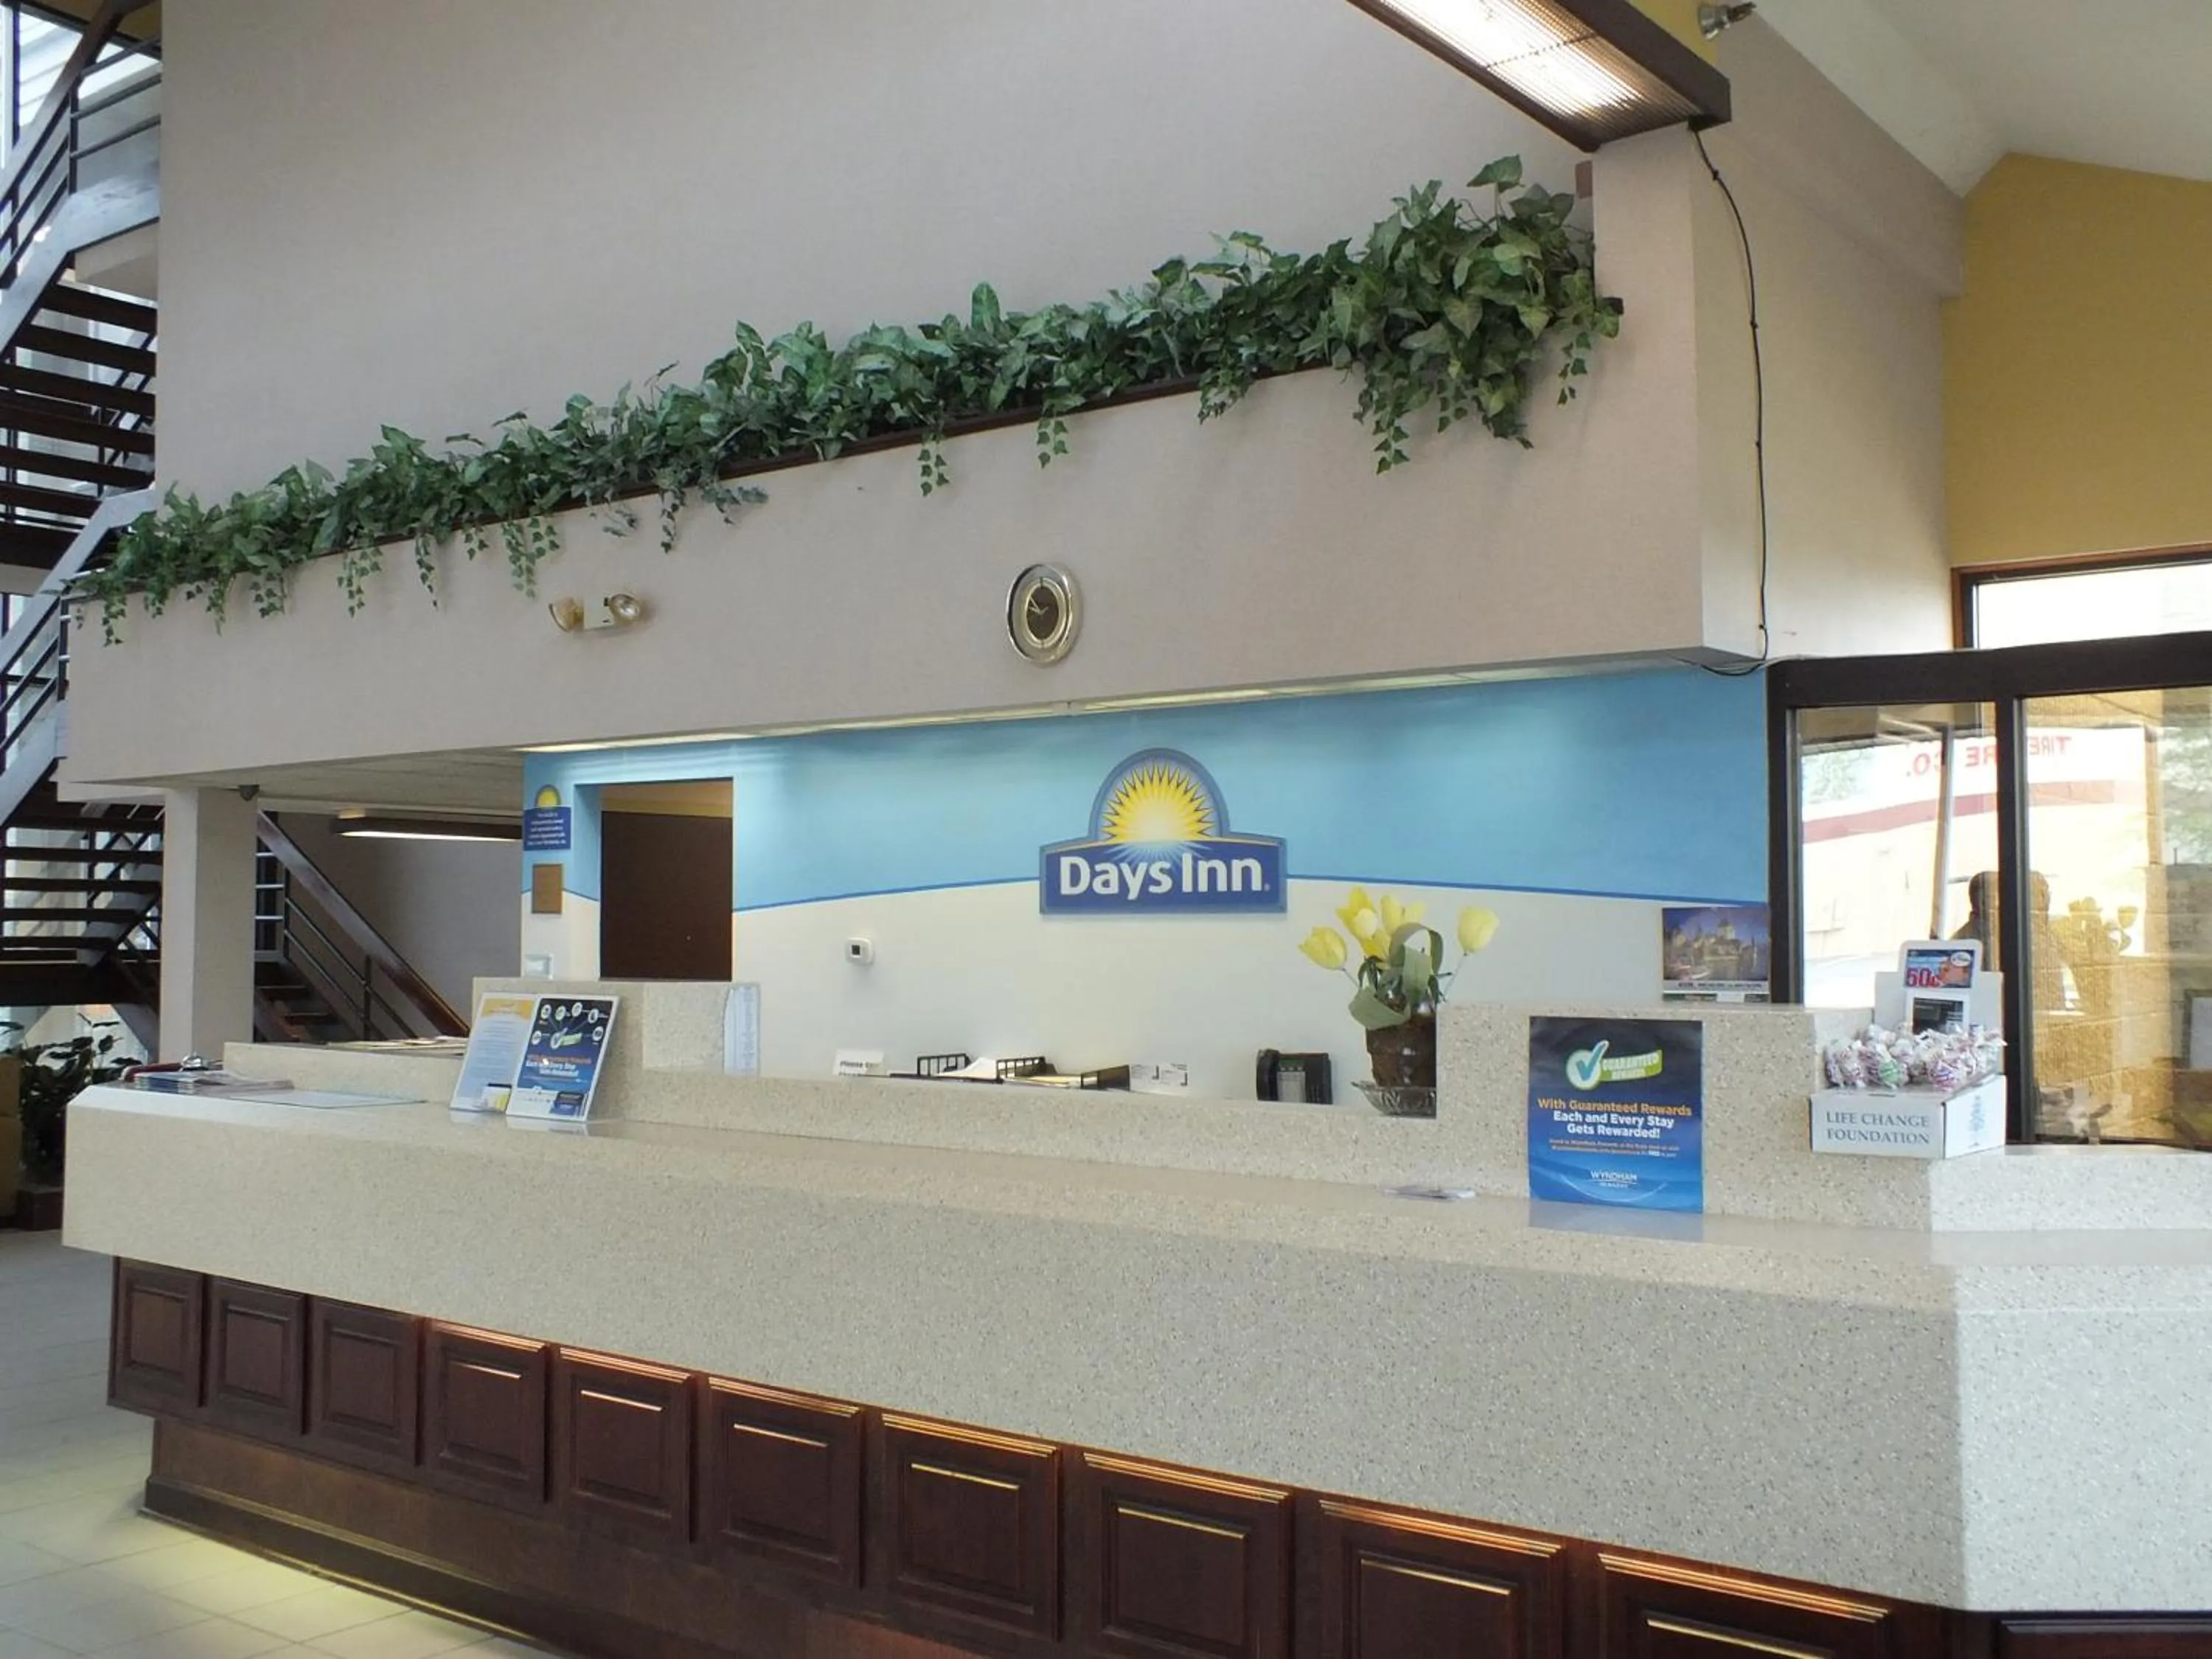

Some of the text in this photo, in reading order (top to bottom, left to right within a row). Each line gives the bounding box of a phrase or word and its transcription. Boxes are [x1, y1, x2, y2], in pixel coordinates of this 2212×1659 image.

[1060, 855, 1172, 901] Days
[1537, 1098, 1692, 1117] With Guaranteed Rewards
[1554, 1110, 1674, 1129] Each and Every Stay
[1826, 1111, 1930, 1127] LIFE CHANGE
[1567, 1124, 1660, 1139] Gets Rewarded!
[1826, 1128, 1930, 1144] FOUNDATION
